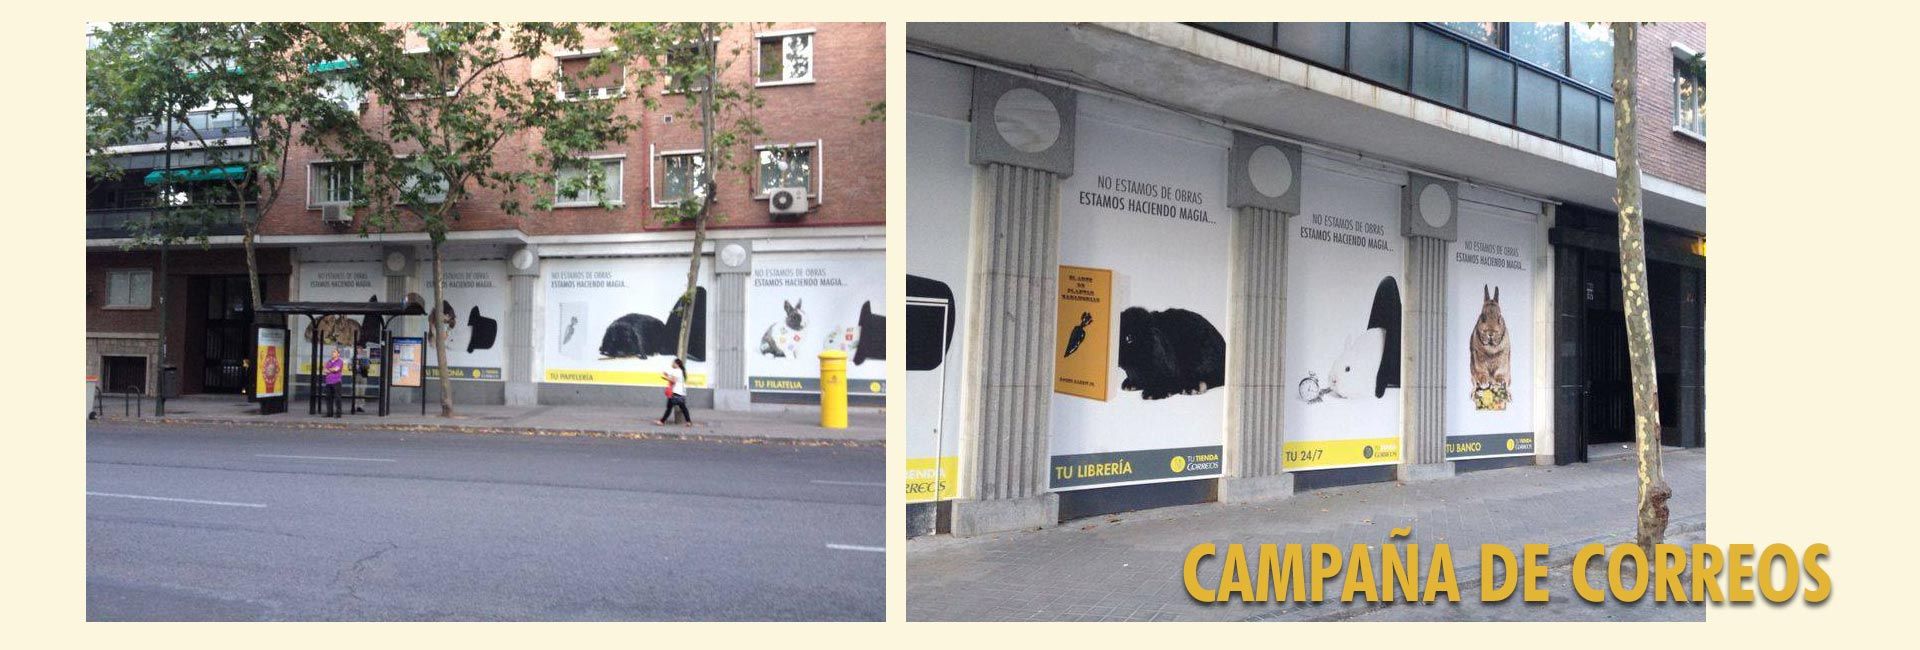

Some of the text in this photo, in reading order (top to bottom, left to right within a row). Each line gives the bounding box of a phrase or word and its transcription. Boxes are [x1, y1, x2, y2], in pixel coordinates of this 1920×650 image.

[1097, 175, 1203, 205] NO ESTAMOS DE OBRAS
[1079, 191, 1216, 225] ESTAMOS HACIENDO MAGIA...
[1312, 213, 1384, 236] NO ESTAMOS DE OBRAS
[1300, 225, 1331, 242] ESTAMOS
[1333, 231, 1366, 248] HACIENDO
[1465, 241, 1519, 258] NO ESTAMOS DE OBRAS
[1456, 251, 1479, 265] ESTAMOS
[1480, 256, 1506, 268] HACIENDO
[755, 268, 826, 277] NO ESTAMOS DE OBRAS
[551, 280, 576, 289] ESTAMOS
[576, 280, 605, 289] HACIENDO
[754, 278, 783, 287] ESTAMOS
[785, 278, 818, 287] HACIENDO
[754, 380, 803, 390] TU FILATELIA
[1285, 449, 1323, 462] TU 24/7
[1446, 442, 1482, 454] TU BANCO
[1195, 453, 1219, 462] TIENDA
[1055, 458, 1133, 480] TU LIBRERÍA
